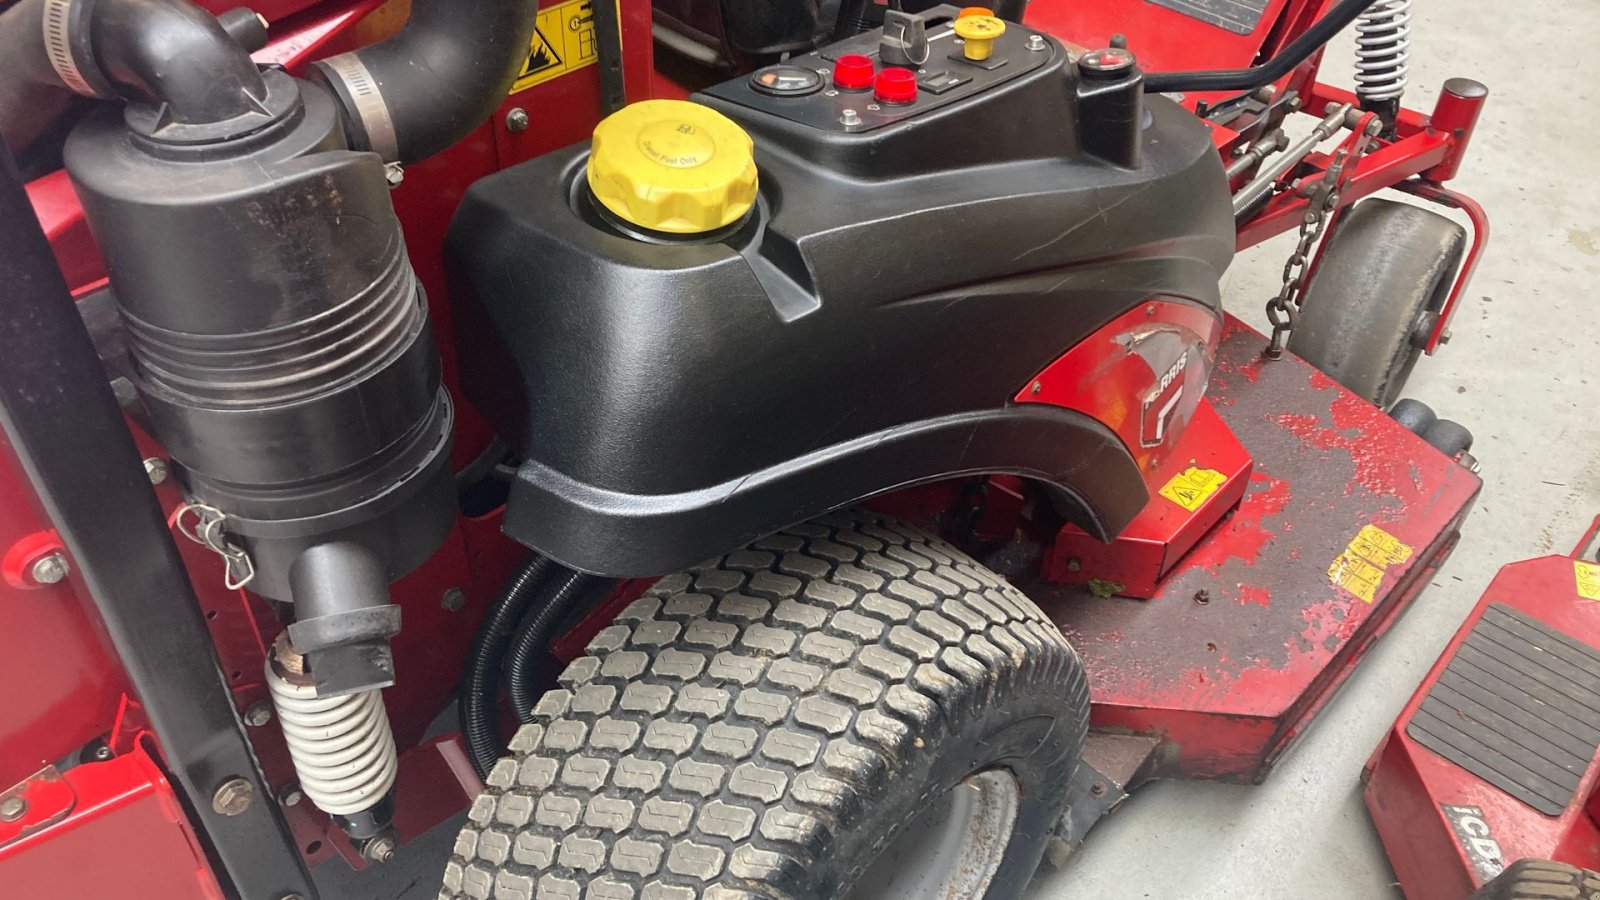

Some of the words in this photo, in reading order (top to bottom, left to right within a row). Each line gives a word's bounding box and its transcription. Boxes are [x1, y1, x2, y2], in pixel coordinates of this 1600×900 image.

[660, 154, 677, 164] Fuel
[680, 156, 698, 165] Only
[1145, 352, 1187, 409] RRIS
